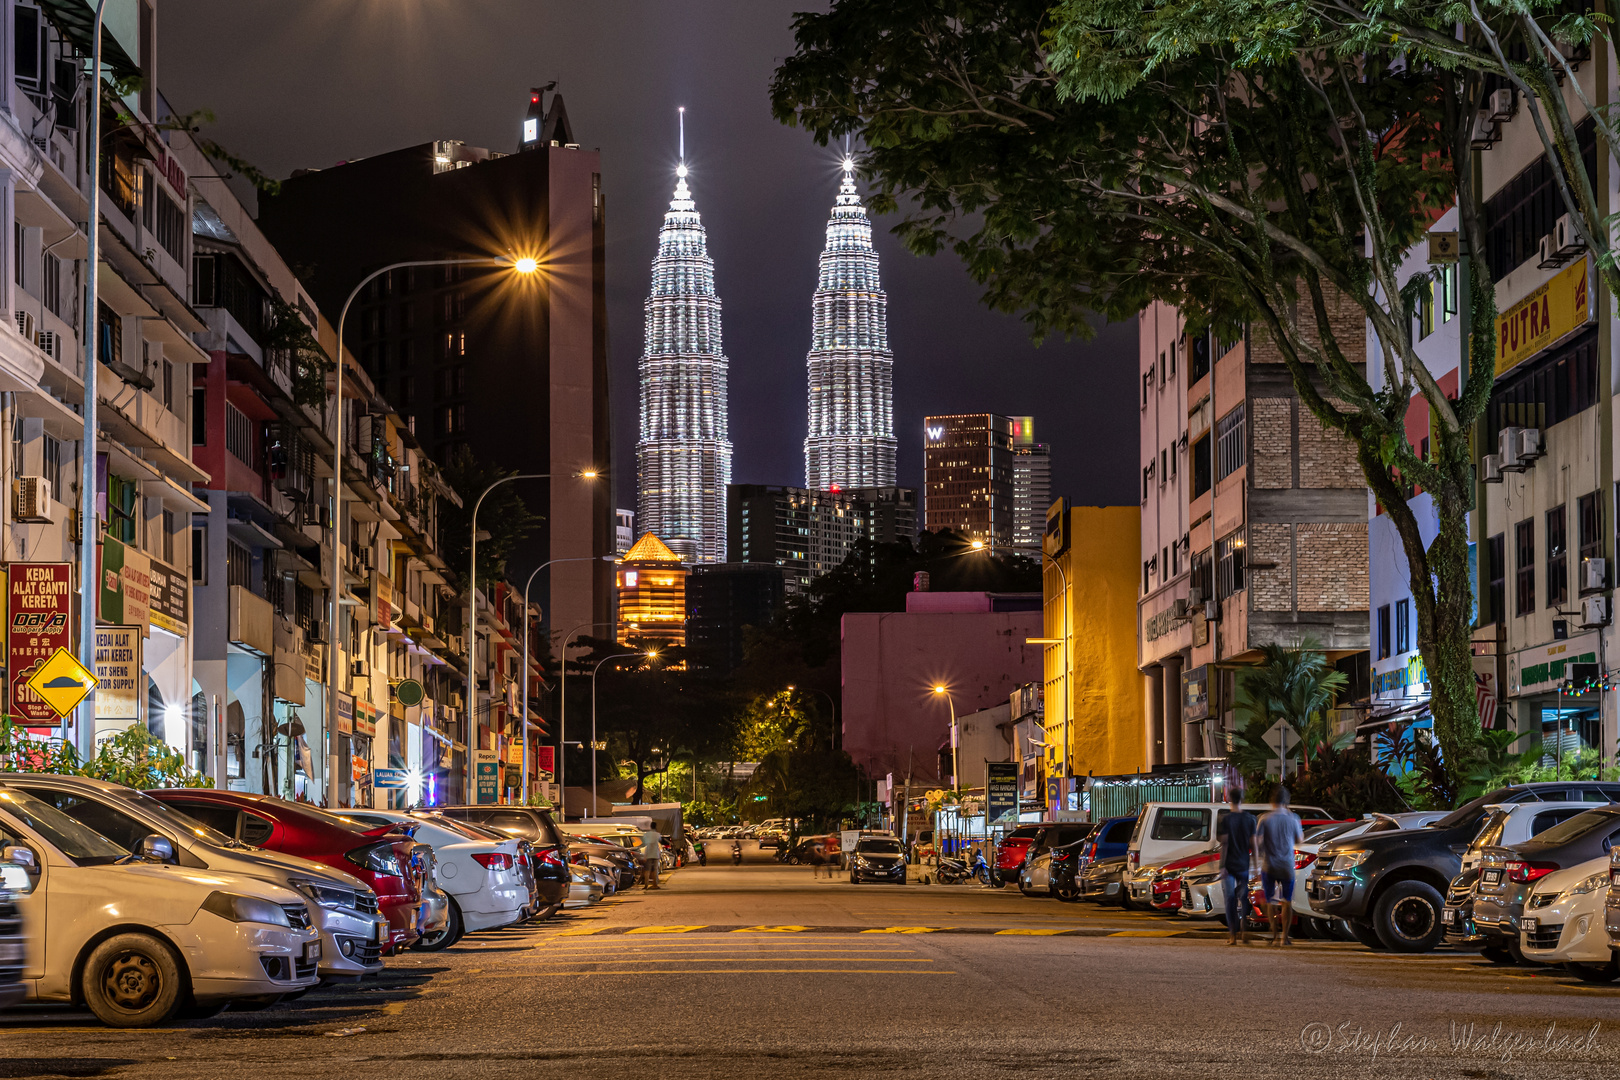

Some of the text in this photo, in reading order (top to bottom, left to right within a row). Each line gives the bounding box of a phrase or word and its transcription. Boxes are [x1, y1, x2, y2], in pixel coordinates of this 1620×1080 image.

[1501, 294, 1550, 359] PUTRA
[927, 427, 942, 440] W
[26, 568, 54, 581] KEDAI
[13, 581, 67, 595] ALAT GANTI
[22, 595, 58, 608] KERETA
[96, 634, 129, 647] KEDAI ALAT
[95, 649, 133, 662] ANTI KERETA
[97, 666, 128, 677] YAT SHENG
[96, 679, 134, 690] OTOR SUPPLY
[17, 684, 41, 702] STO
